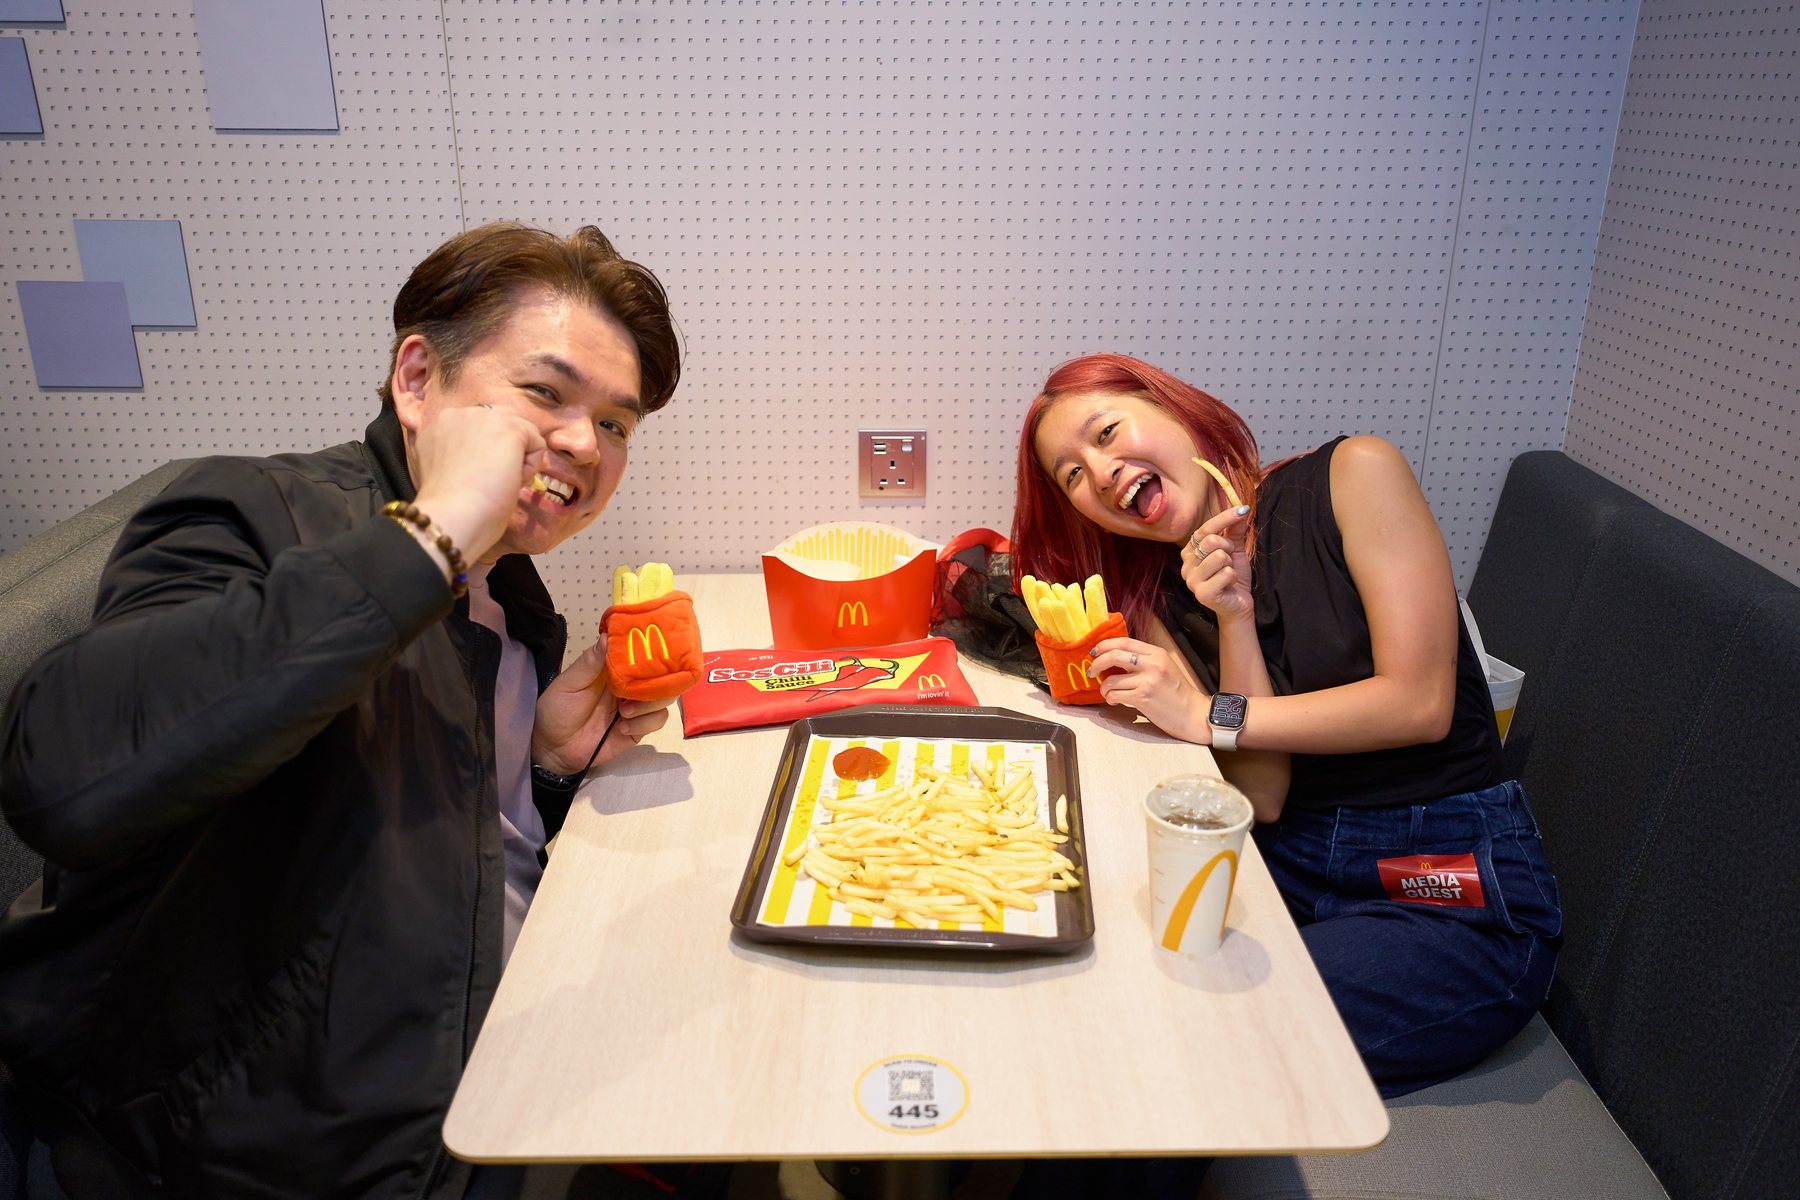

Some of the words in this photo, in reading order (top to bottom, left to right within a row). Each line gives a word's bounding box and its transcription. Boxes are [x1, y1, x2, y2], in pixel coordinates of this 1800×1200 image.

[709, 659, 836, 682] SosCili
[765, 675, 812, 685] Chilli
[766, 680, 815, 690] Sauce
[1400, 873, 1460, 890] MEDIA
[1405, 887, 1462, 899] GUEST
[888, 1104, 939, 1119] 445
